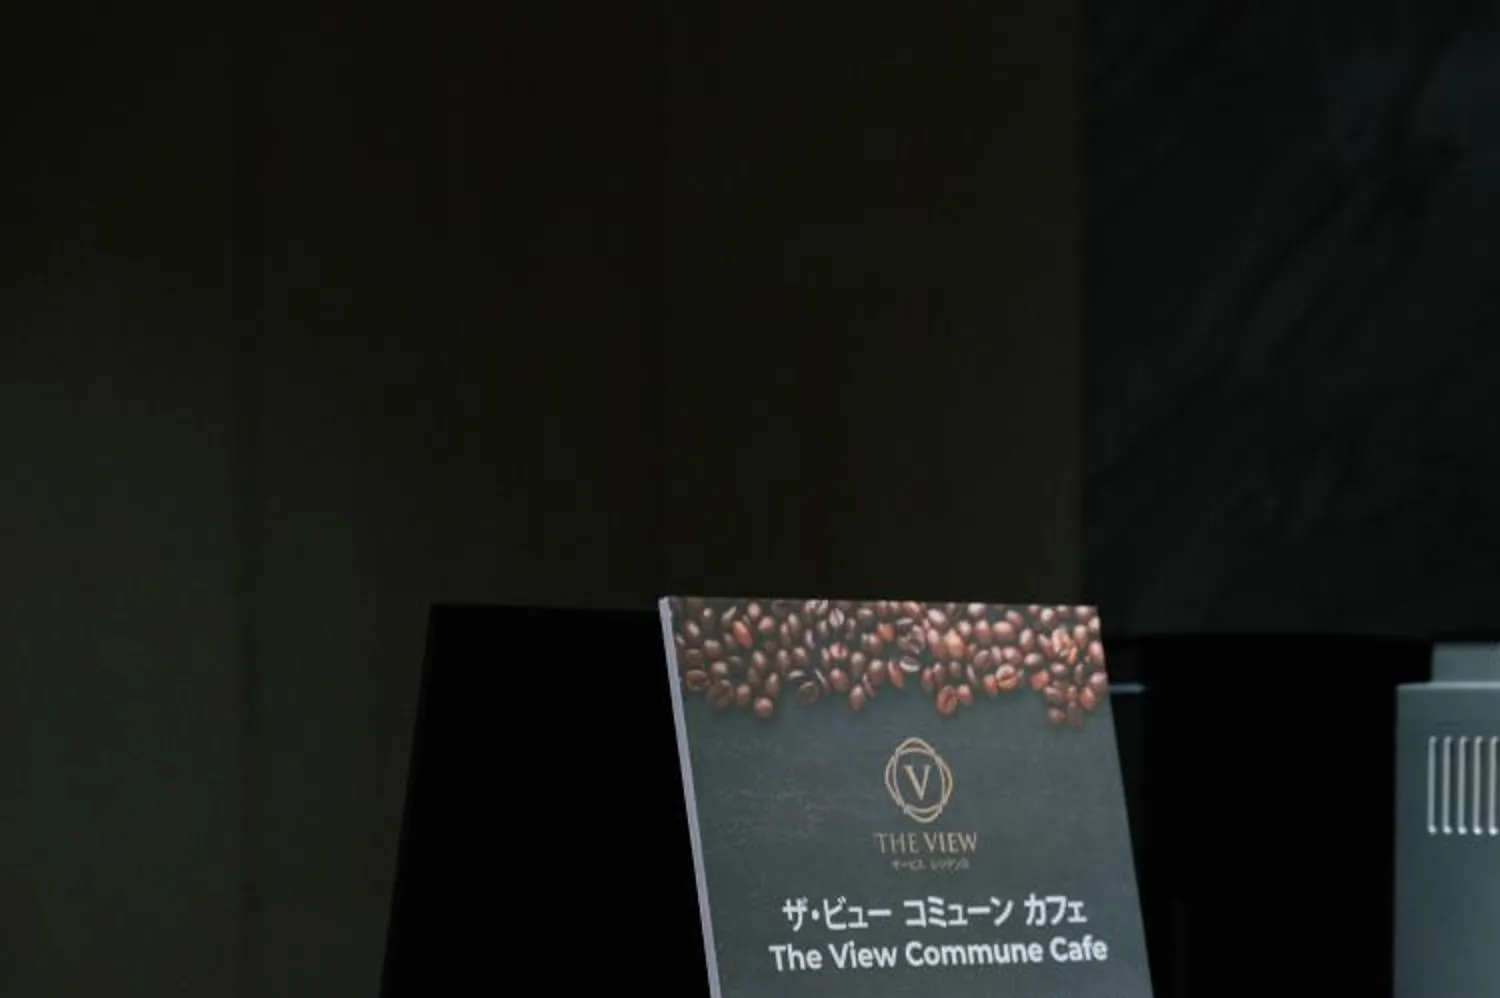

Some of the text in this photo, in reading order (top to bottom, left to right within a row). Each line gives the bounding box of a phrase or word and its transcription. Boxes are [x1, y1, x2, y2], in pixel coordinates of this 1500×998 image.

[904, 764, 931, 800] V
[875, 831, 978, 855] THE VIEW
[782, 892, 1088, 932] ザ・ビュー コミューン カフェ
[769, 934, 1109, 972] The View Commune Cafe
